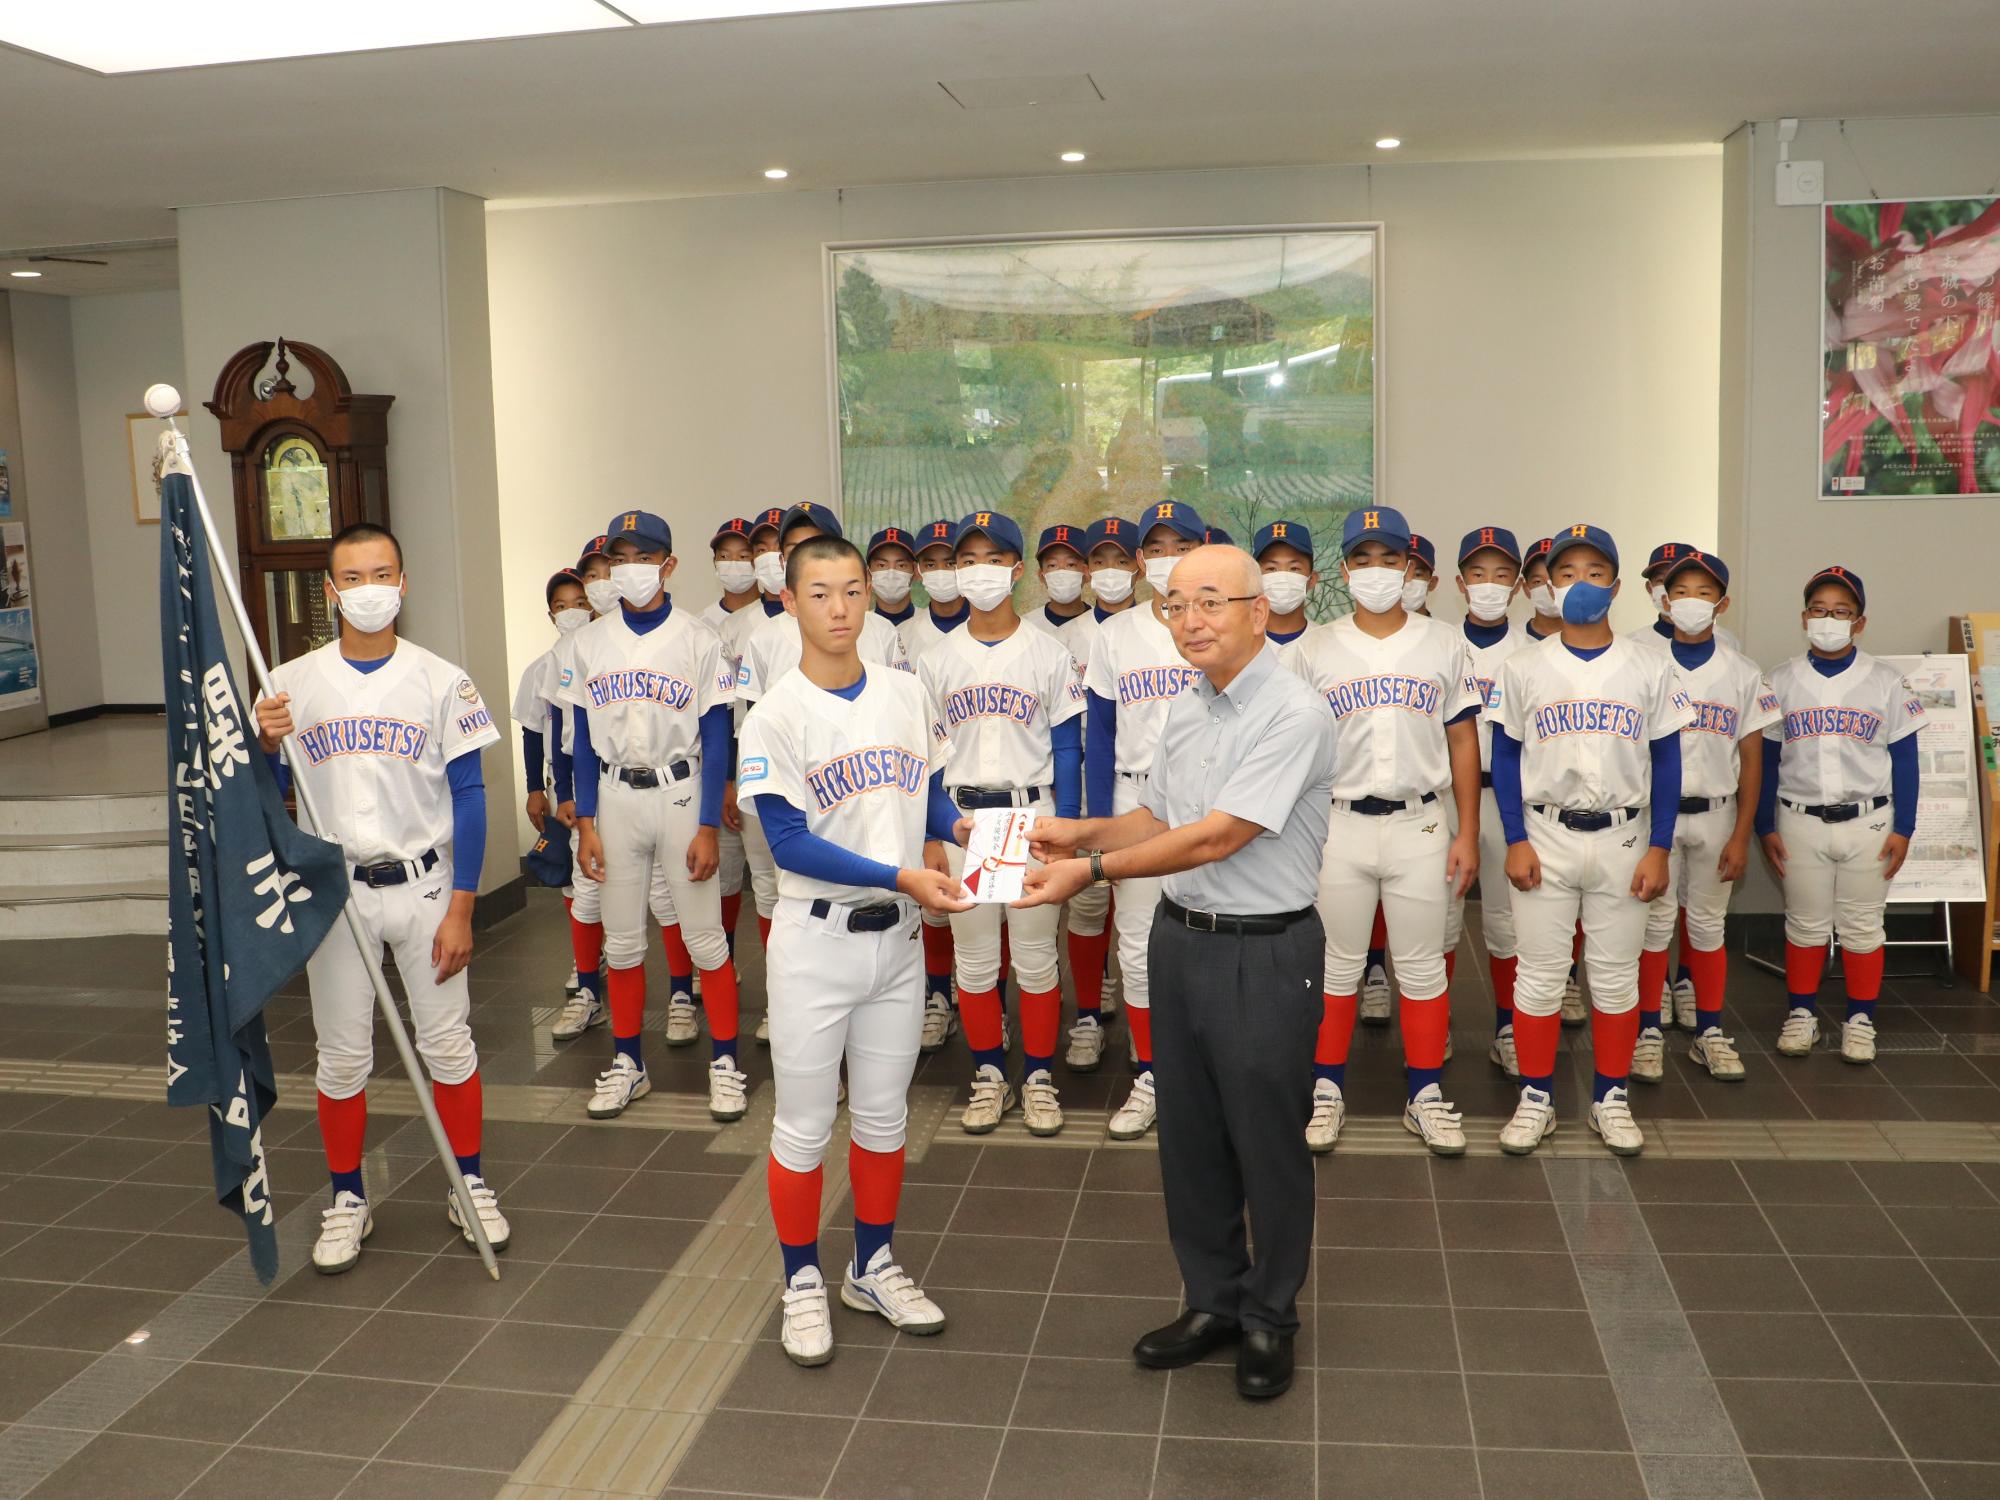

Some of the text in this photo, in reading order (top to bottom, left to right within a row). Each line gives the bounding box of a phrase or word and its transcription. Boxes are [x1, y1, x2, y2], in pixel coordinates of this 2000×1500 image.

[768, 510, 781, 524] H
[1156, 503, 1174, 519] H
[621, 515, 638, 531] H
[731, 518, 743, 531] H
[975, 513, 992, 527] H
[1105, 519, 1120, 535] H
[1363, 511, 1380, 529] H
[886, 529, 898, 542] H
[933, 523, 948, 537] H
[1056, 527, 1069, 541] H
[1272, 523, 1287, 537] H
[1480, 528, 1495, 544] H
[1571, 525, 1588, 538] H
[1540, 539, 1552, 553] H
[1663, 545, 1676, 559] H
[586, 669, 696, 711] HOKUSETSU
[946, 684, 1040, 727] HOKUSETSU
[1325, 674, 1441, 722] HOKUSETSU
[1535, 701, 1645, 744] HOKUSETSU
[299, 717, 428, 765] HOKUSETSU
[534, 838, 550, 853] H
